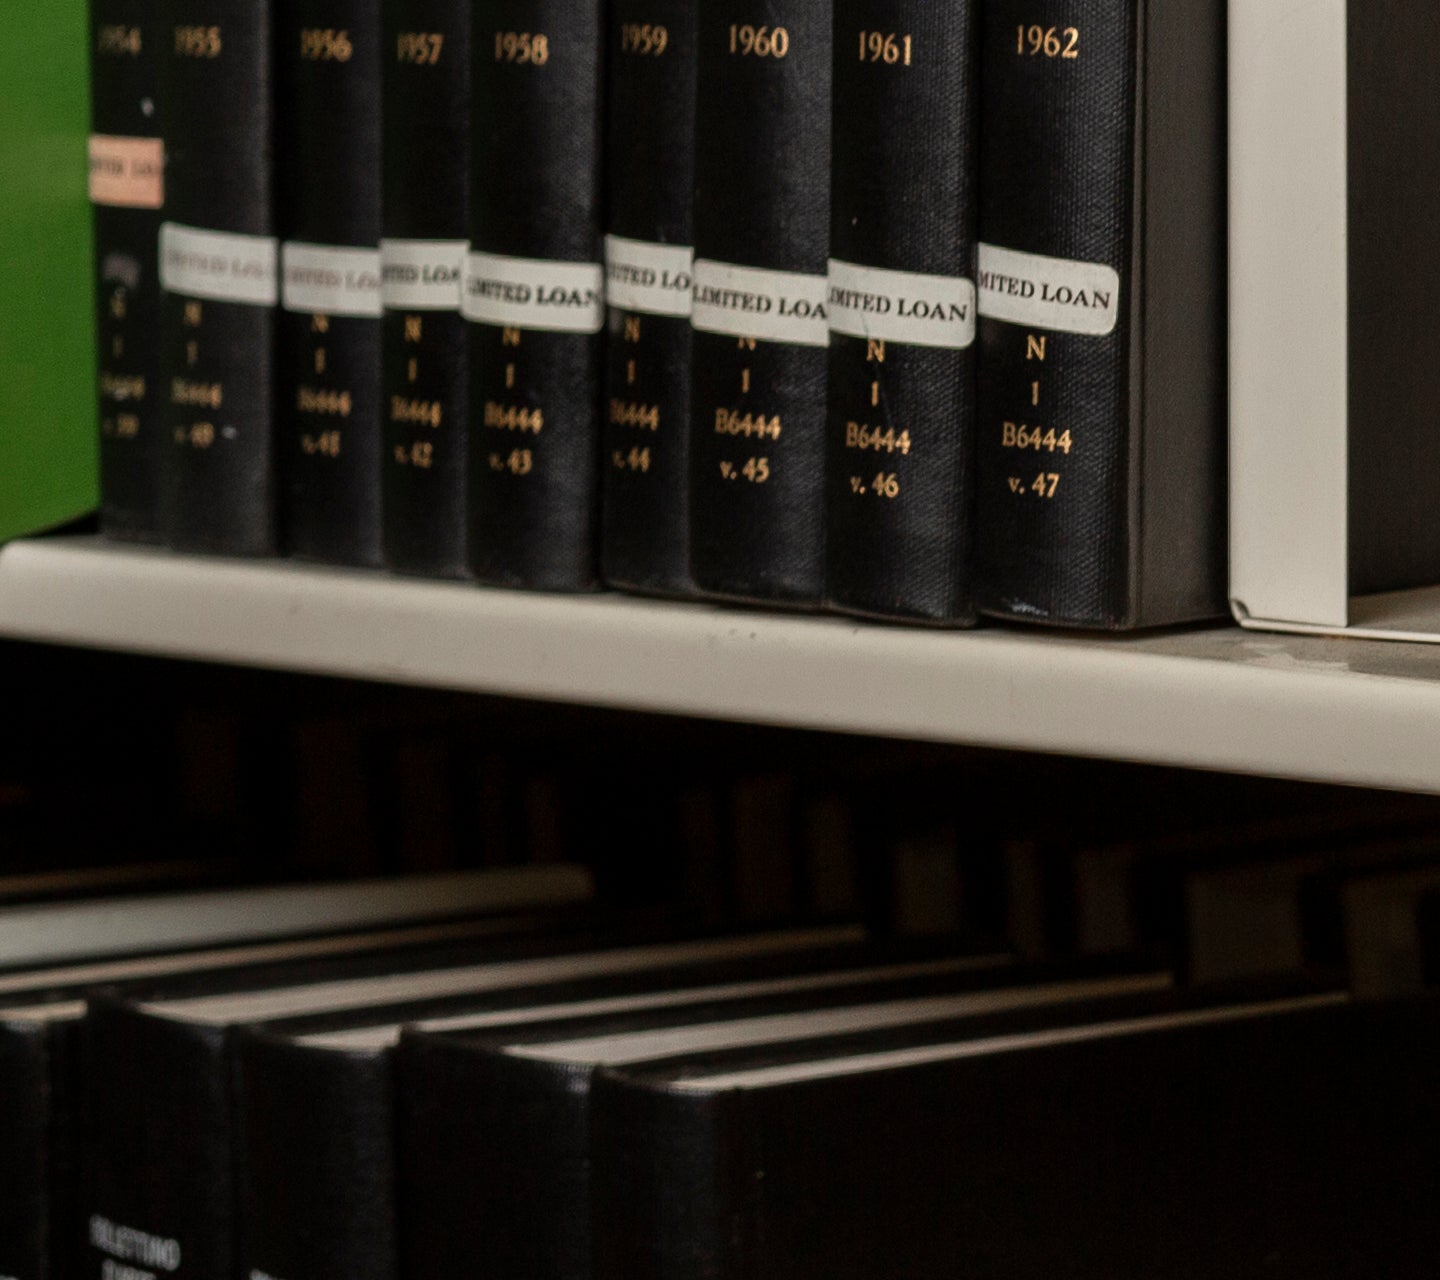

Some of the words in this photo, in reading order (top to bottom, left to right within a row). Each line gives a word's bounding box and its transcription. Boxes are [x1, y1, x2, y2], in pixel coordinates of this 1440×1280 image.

[494, 30, 549, 66] 1958
[619, 23, 669, 57] 1959
[728, 22, 791, 59] 1960
[857, 30, 913, 67] 1961
[1016, 23, 1080, 60] 1962
[692, 283, 772, 314] LIMITED
[896, 297, 968, 324] LOAN
[1041, 282, 1112, 311] LOAN
[866, 336, 886, 363] N
[1025, 334, 1047, 362] N
[714, 407, 782, 441] B6444
[845, 420, 912, 456] B6444
[1001, 420, 1073, 456] B6444
[507, 448, 533, 476] 43
[627, 446, 651, 473] 44
[719, 460, 738, 481] v.
[742, 457, 771, 484] 45
[849, 475, 867, 495] v.
[871, 471, 900, 498] 46
[1007, 476, 1026, 495] v.
[1031, 471, 1060, 498] 47
